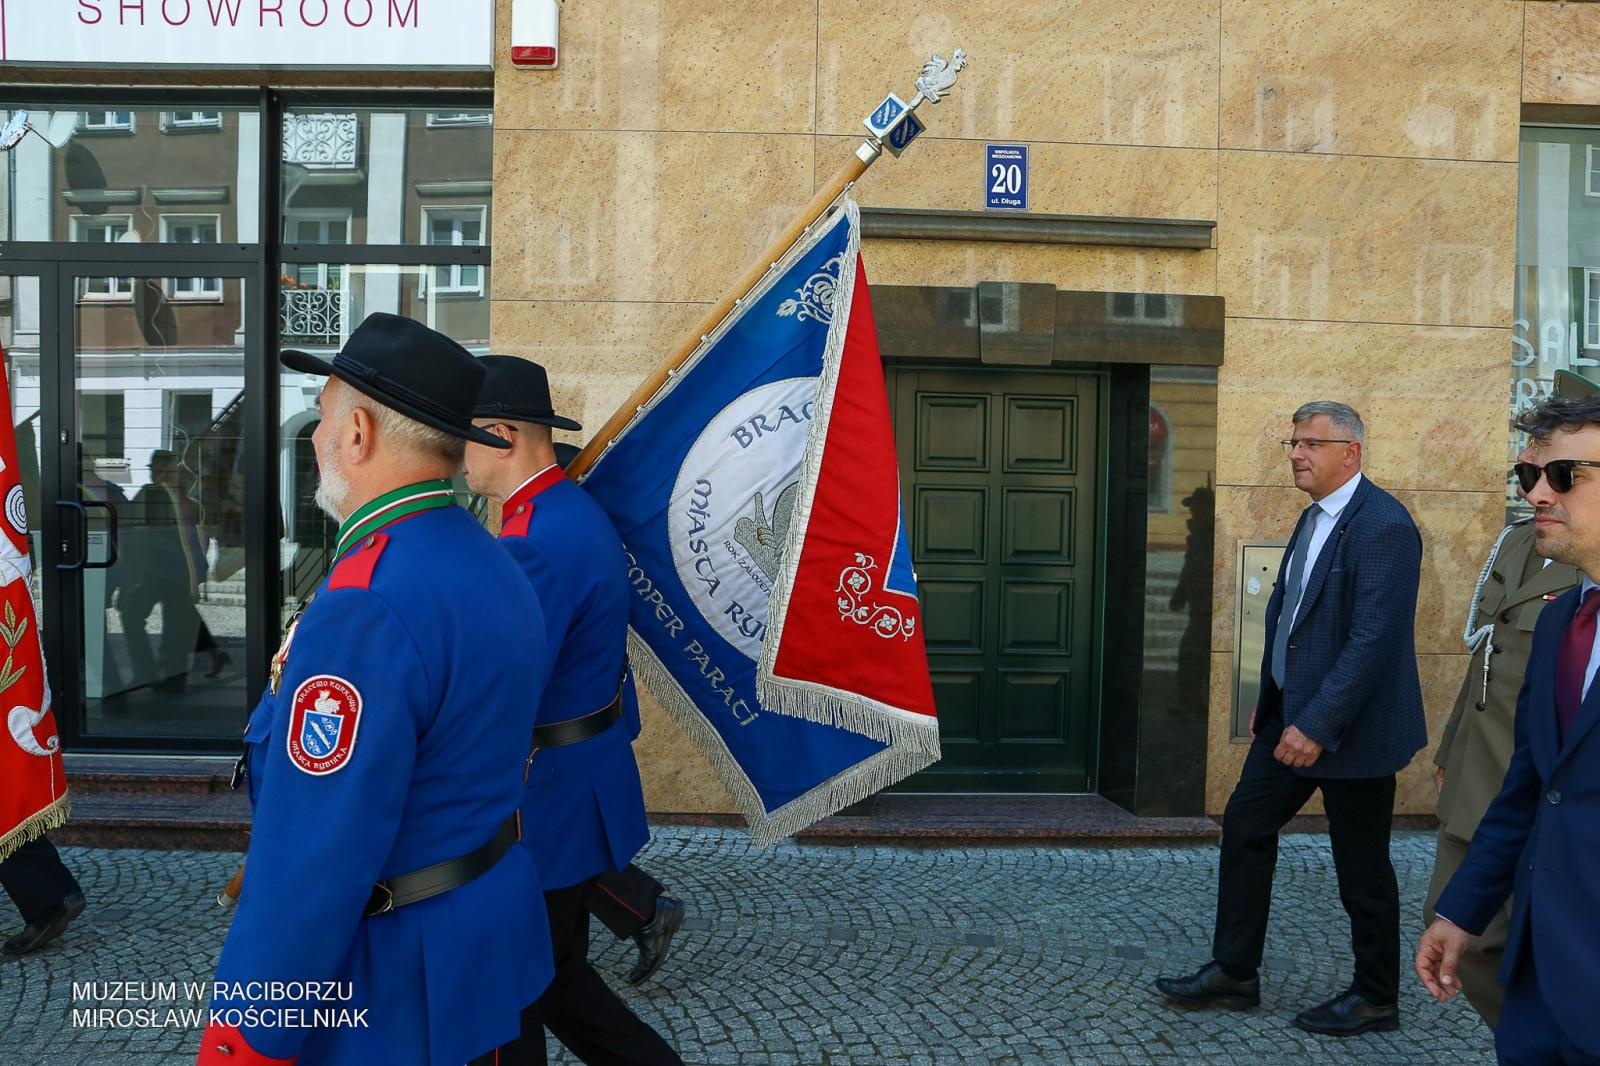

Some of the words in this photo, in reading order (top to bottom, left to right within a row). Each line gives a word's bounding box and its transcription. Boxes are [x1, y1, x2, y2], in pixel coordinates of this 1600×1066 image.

[77, 0, 419, 28] SHOWROOM
[991, 163, 1022, 194] 20
[723, 540, 741, 560] ROK
